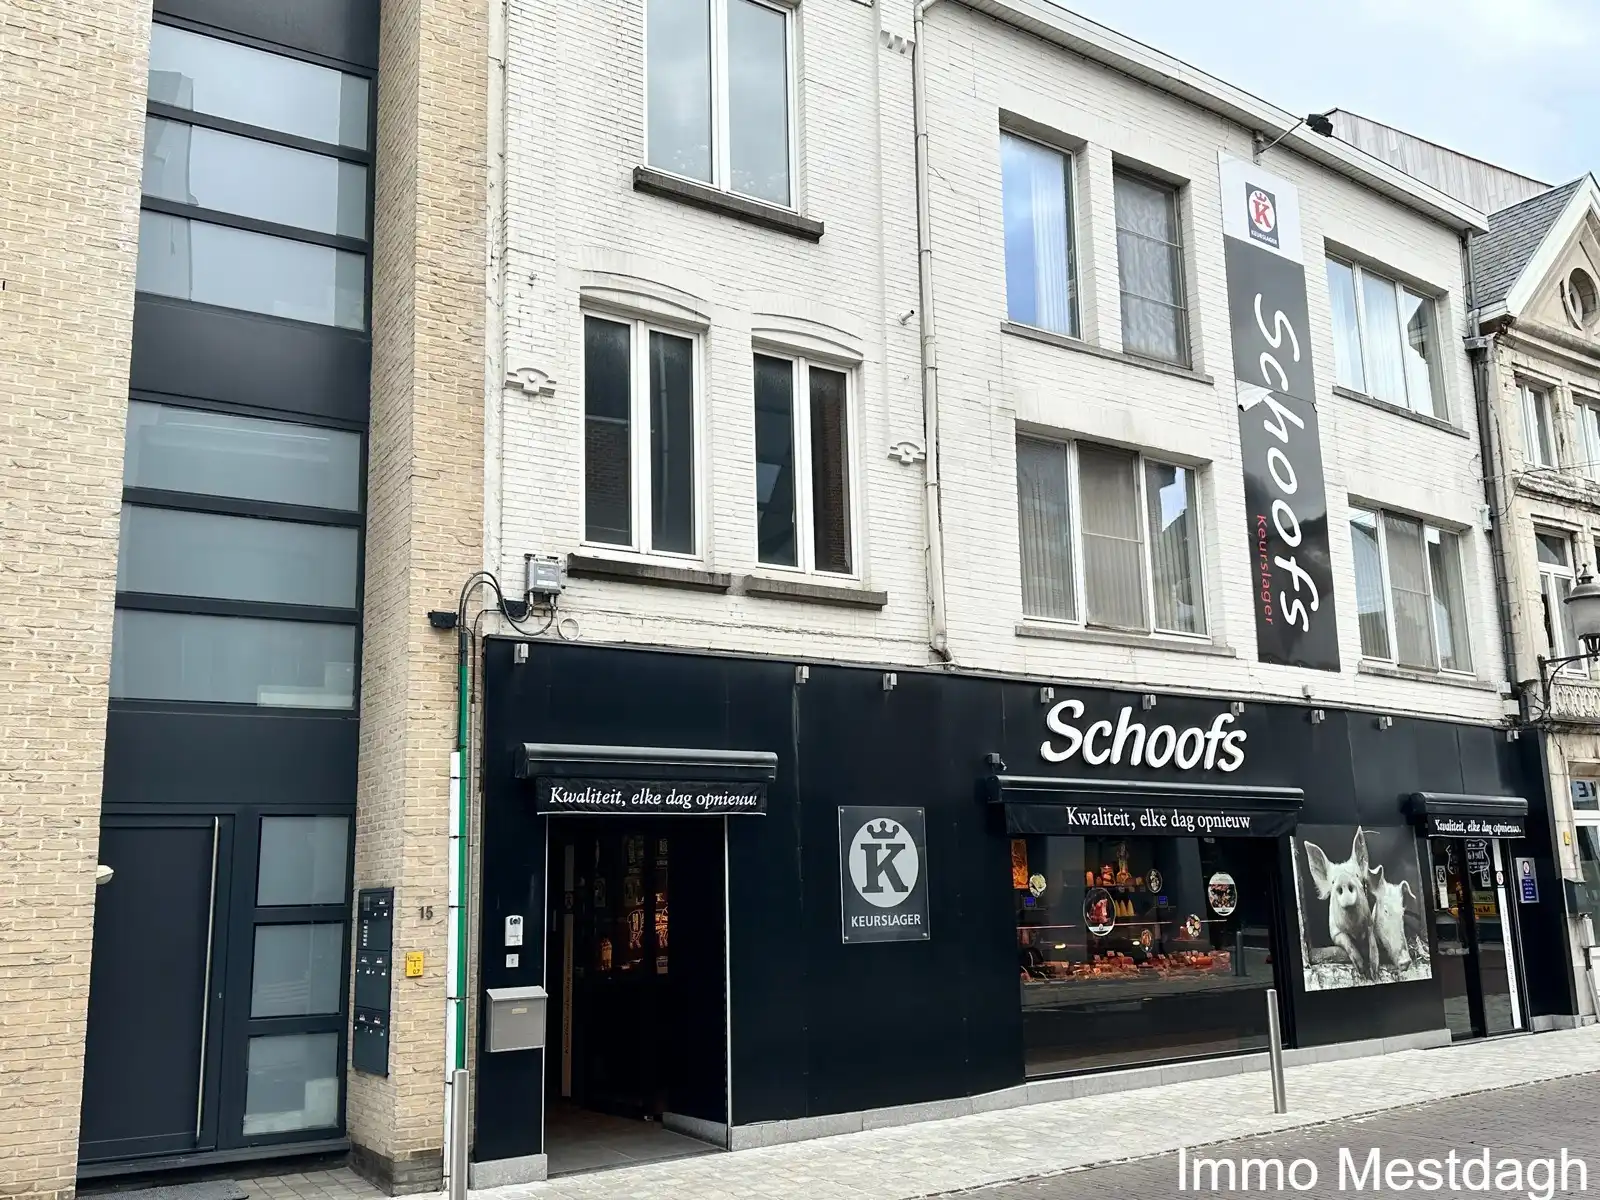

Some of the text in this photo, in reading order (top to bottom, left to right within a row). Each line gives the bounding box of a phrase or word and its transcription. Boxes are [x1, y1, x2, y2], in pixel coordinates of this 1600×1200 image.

[1253, 200, 1272, 229] K
[1254, 293, 1319, 633] Schoofs
[1256, 514, 1274, 626] Keurslager
[1040, 699, 1248, 772] Schoofs
[549, 786, 626, 806] Kwaliteit,
[631, 788, 661, 805] elke
[665, 788, 691, 809] dag
[1066, 807, 1251, 832] Kwaliteit, elke dag opnieuw
[1467, 819, 1480, 832] elke
[1481, 820, 1493, 835] dag
[860, 843, 909, 893] K
[418, 906, 434, 920] 15
[851, 913, 921, 928] KEURSLAGER
